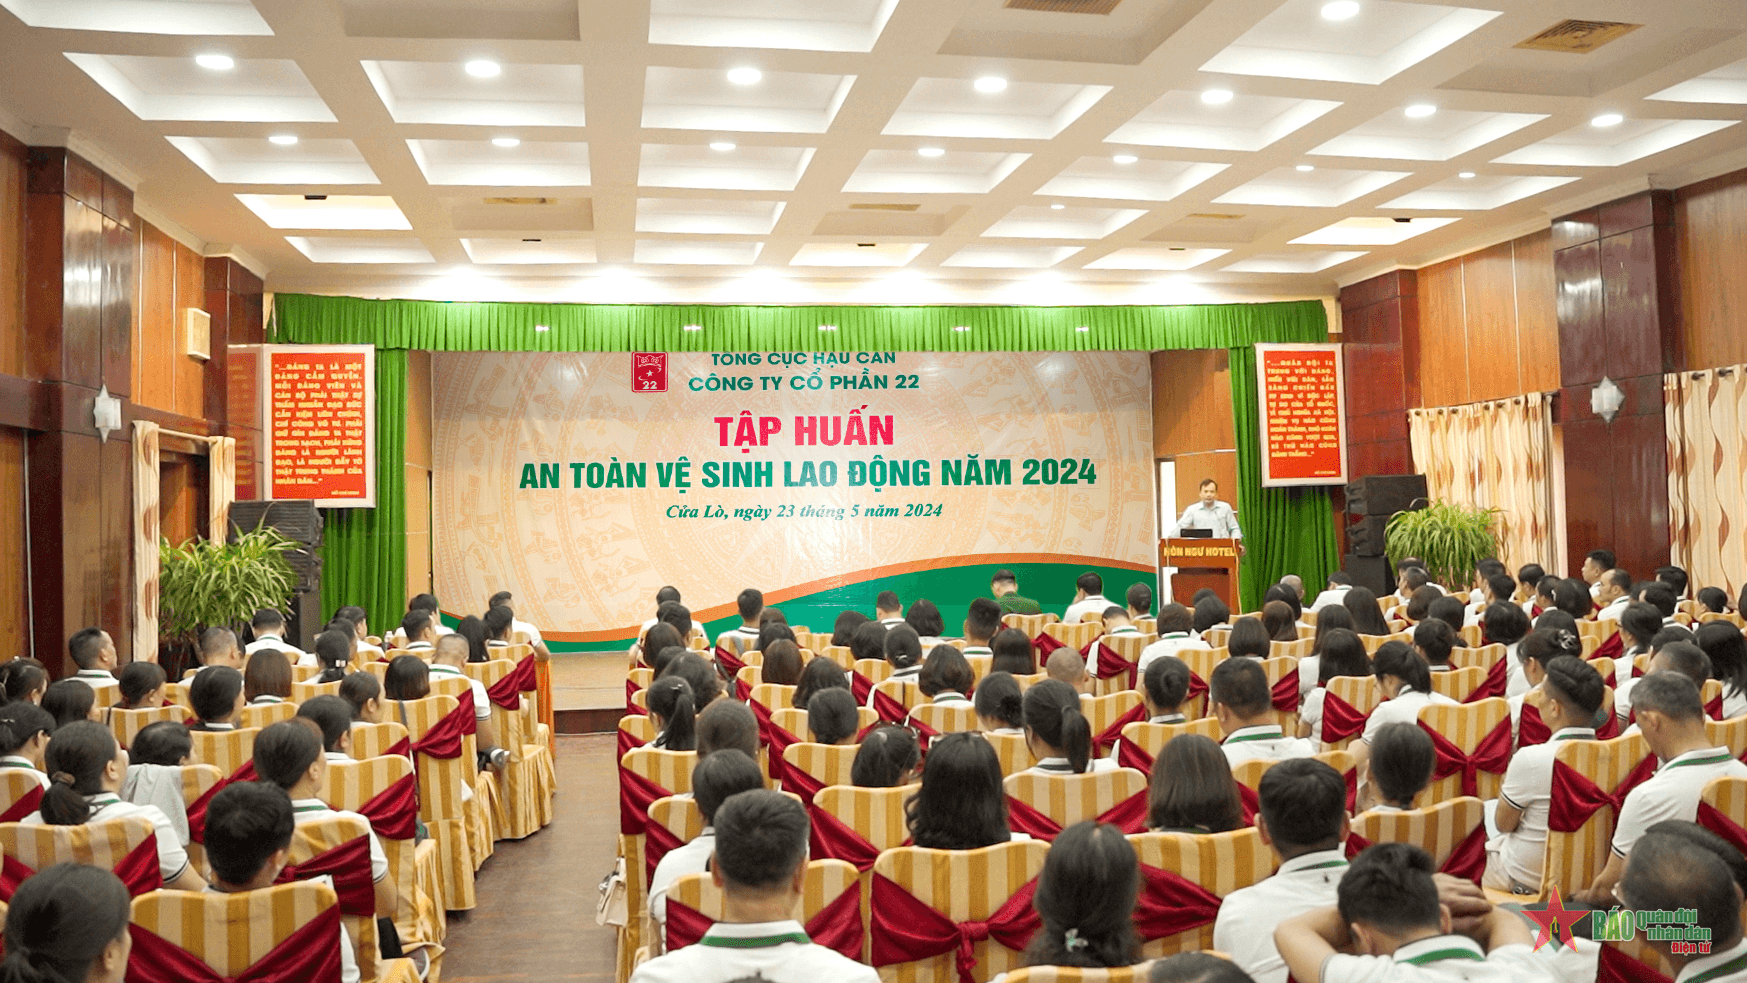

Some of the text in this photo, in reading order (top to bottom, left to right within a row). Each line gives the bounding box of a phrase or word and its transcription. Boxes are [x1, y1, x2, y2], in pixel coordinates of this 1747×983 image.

[767, 352, 807, 369] CỤC
[642, 381, 657, 389] 22
[689, 367, 919, 392] CÔNG TY CỔ PHẦN 22
[714, 404, 894, 453] TẬP HUẤN
[519, 454, 1096, 494] AN TOÀN VỆ SINH LAO ĐỘNG NĂM 2024
[666, 503, 943, 522] Cửa Lò, ngày 23 tháng 5 năm 2024
[1206, 547, 1236, 556] HOTEL
